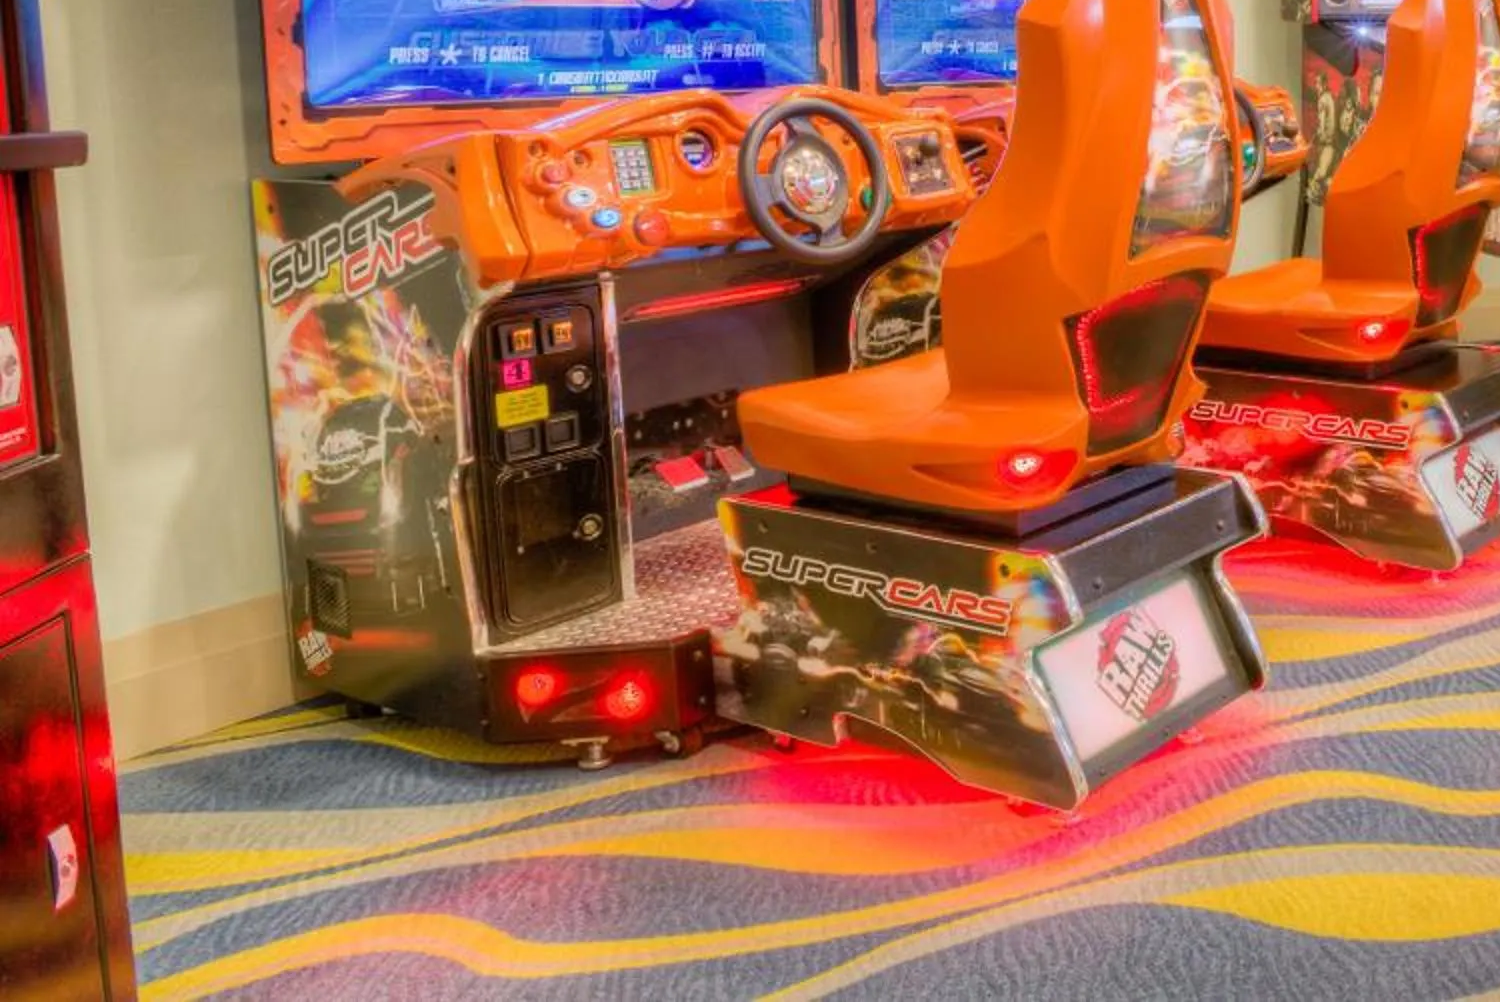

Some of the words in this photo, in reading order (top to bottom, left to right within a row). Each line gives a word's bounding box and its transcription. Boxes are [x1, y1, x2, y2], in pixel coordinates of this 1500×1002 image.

[389, 45, 430, 65] PRESS
[471, 47, 487, 64] TO
[489, 46, 531, 64] CANCEL
[267, 189, 400, 306] SUPER
[1189, 400, 1412, 446] SUPERCARS
[742, 548, 1014, 634] SUPERCARS
[1097, 604, 1160, 710] RAW
